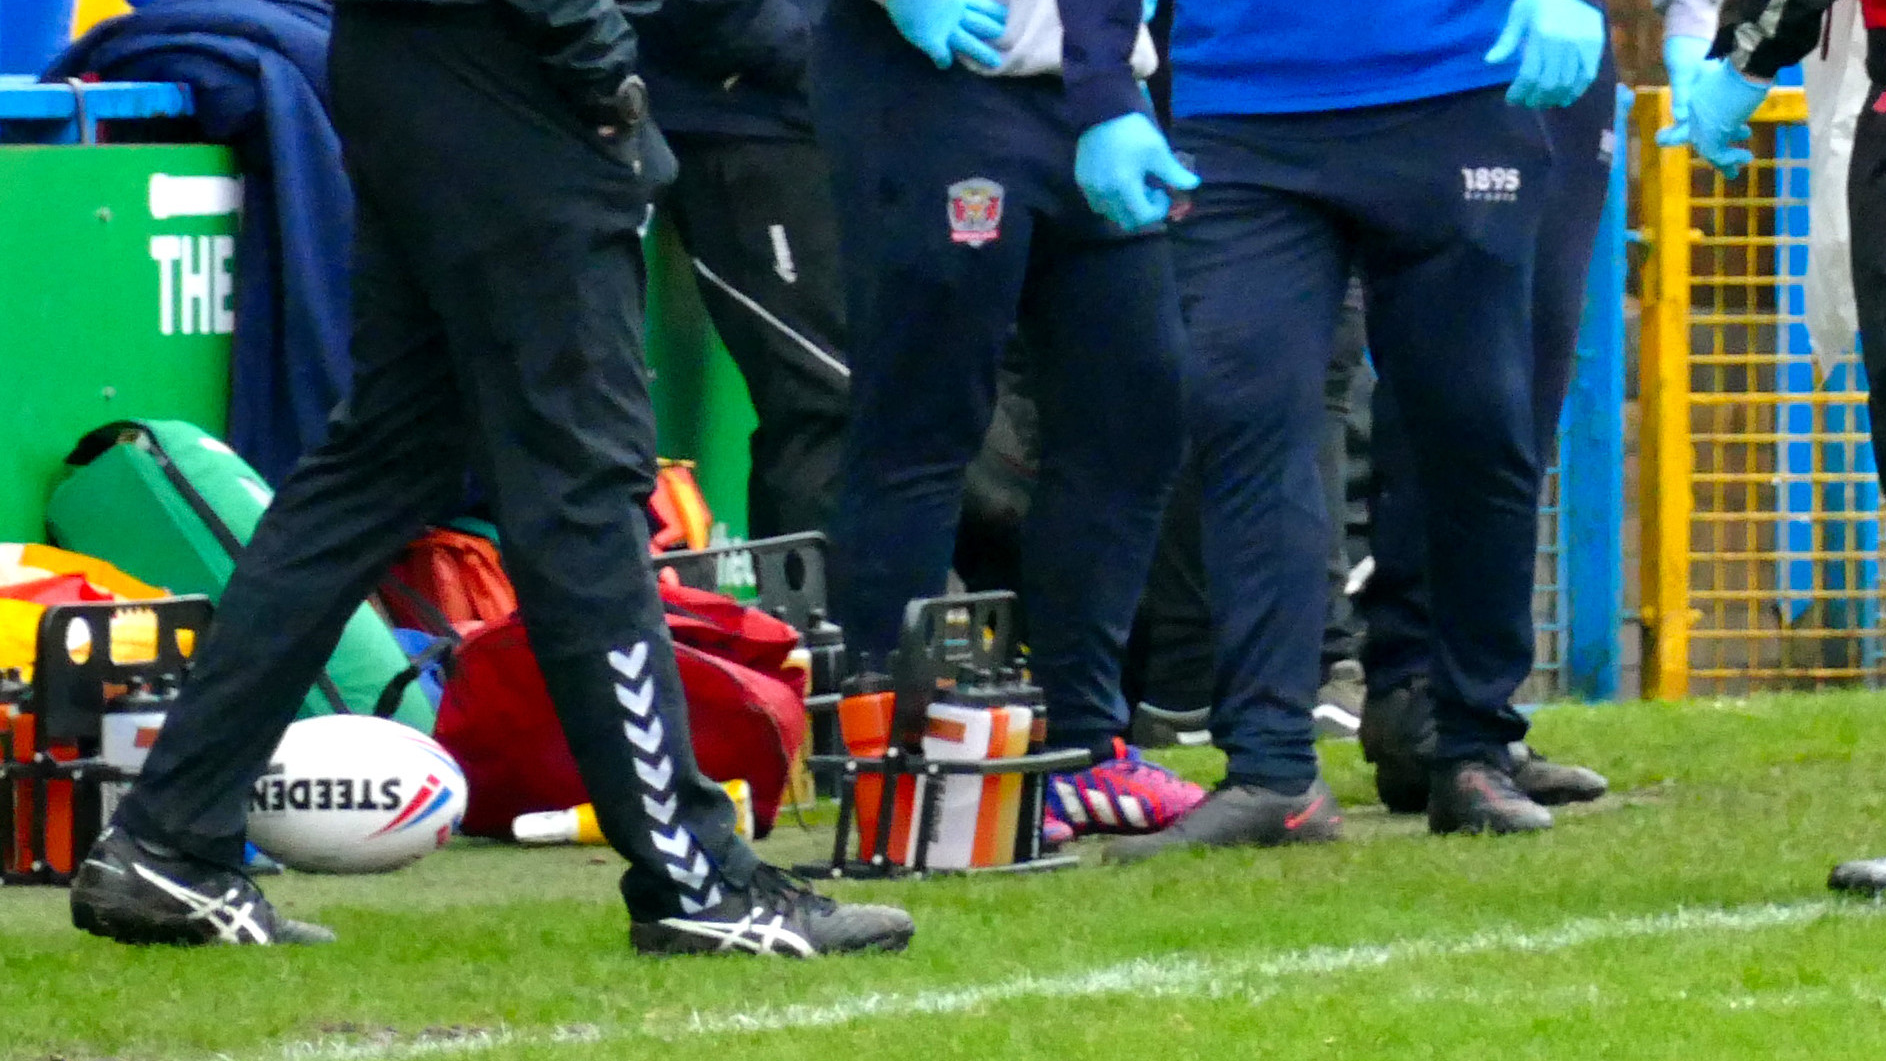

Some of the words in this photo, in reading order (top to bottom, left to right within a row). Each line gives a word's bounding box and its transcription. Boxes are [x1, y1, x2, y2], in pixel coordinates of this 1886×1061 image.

[1460, 165, 1521, 192] 1895
[149, 234, 235, 336] THE
[251, 777, 402, 812] STEEDEN
